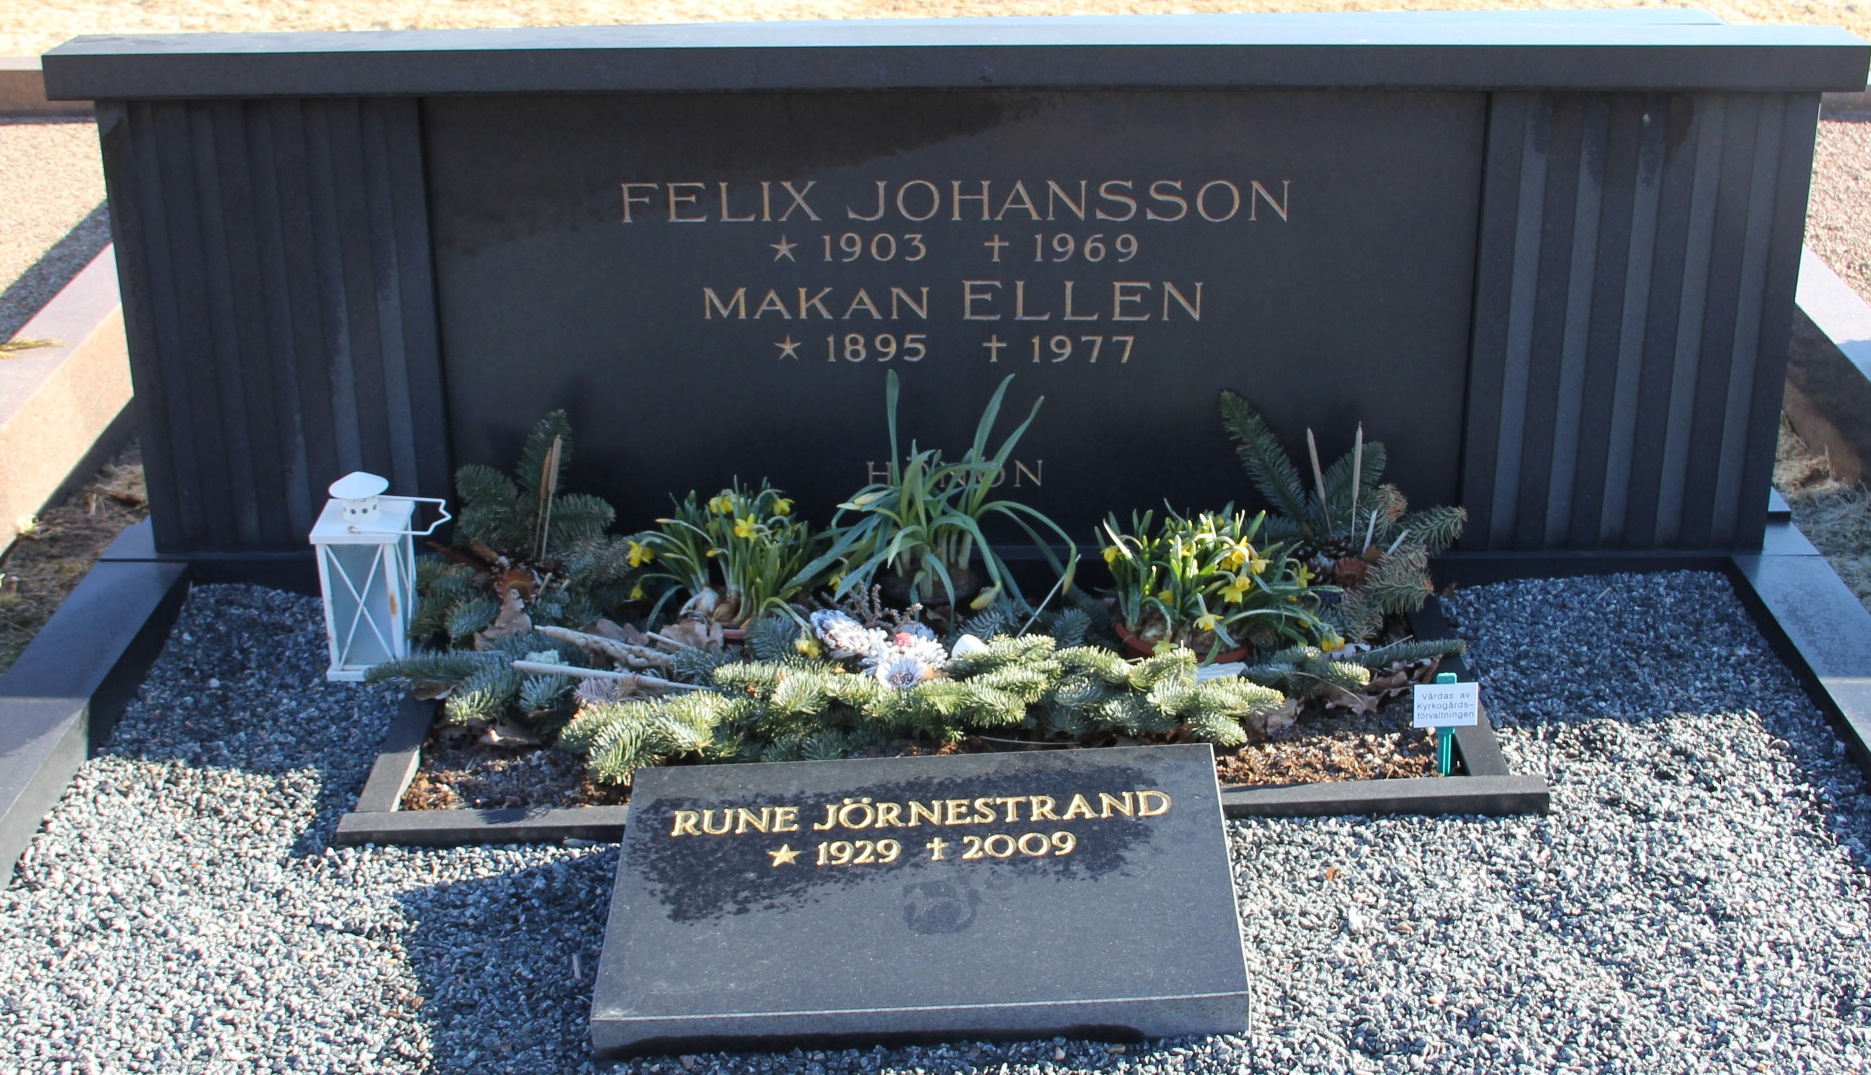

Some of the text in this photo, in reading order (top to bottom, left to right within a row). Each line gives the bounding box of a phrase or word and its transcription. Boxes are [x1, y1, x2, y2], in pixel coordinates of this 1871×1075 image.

[621, 179, 1291, 223] FELIX JOHANSSON
[822, 232, 1139, 263] 1903 1969
[703, 279, 1203, 321] MAKAN ELLEN
[826, 332, 1135, 364] 1895 1977
[1422, 692, 1453, 700] Vårdas
[1417, 711, 1474, 719] förvaltningen
[670, 789, 1173, 837] RUNE JÖRNESTRAND
[816, 831, 1078, 866] 1929 2009
